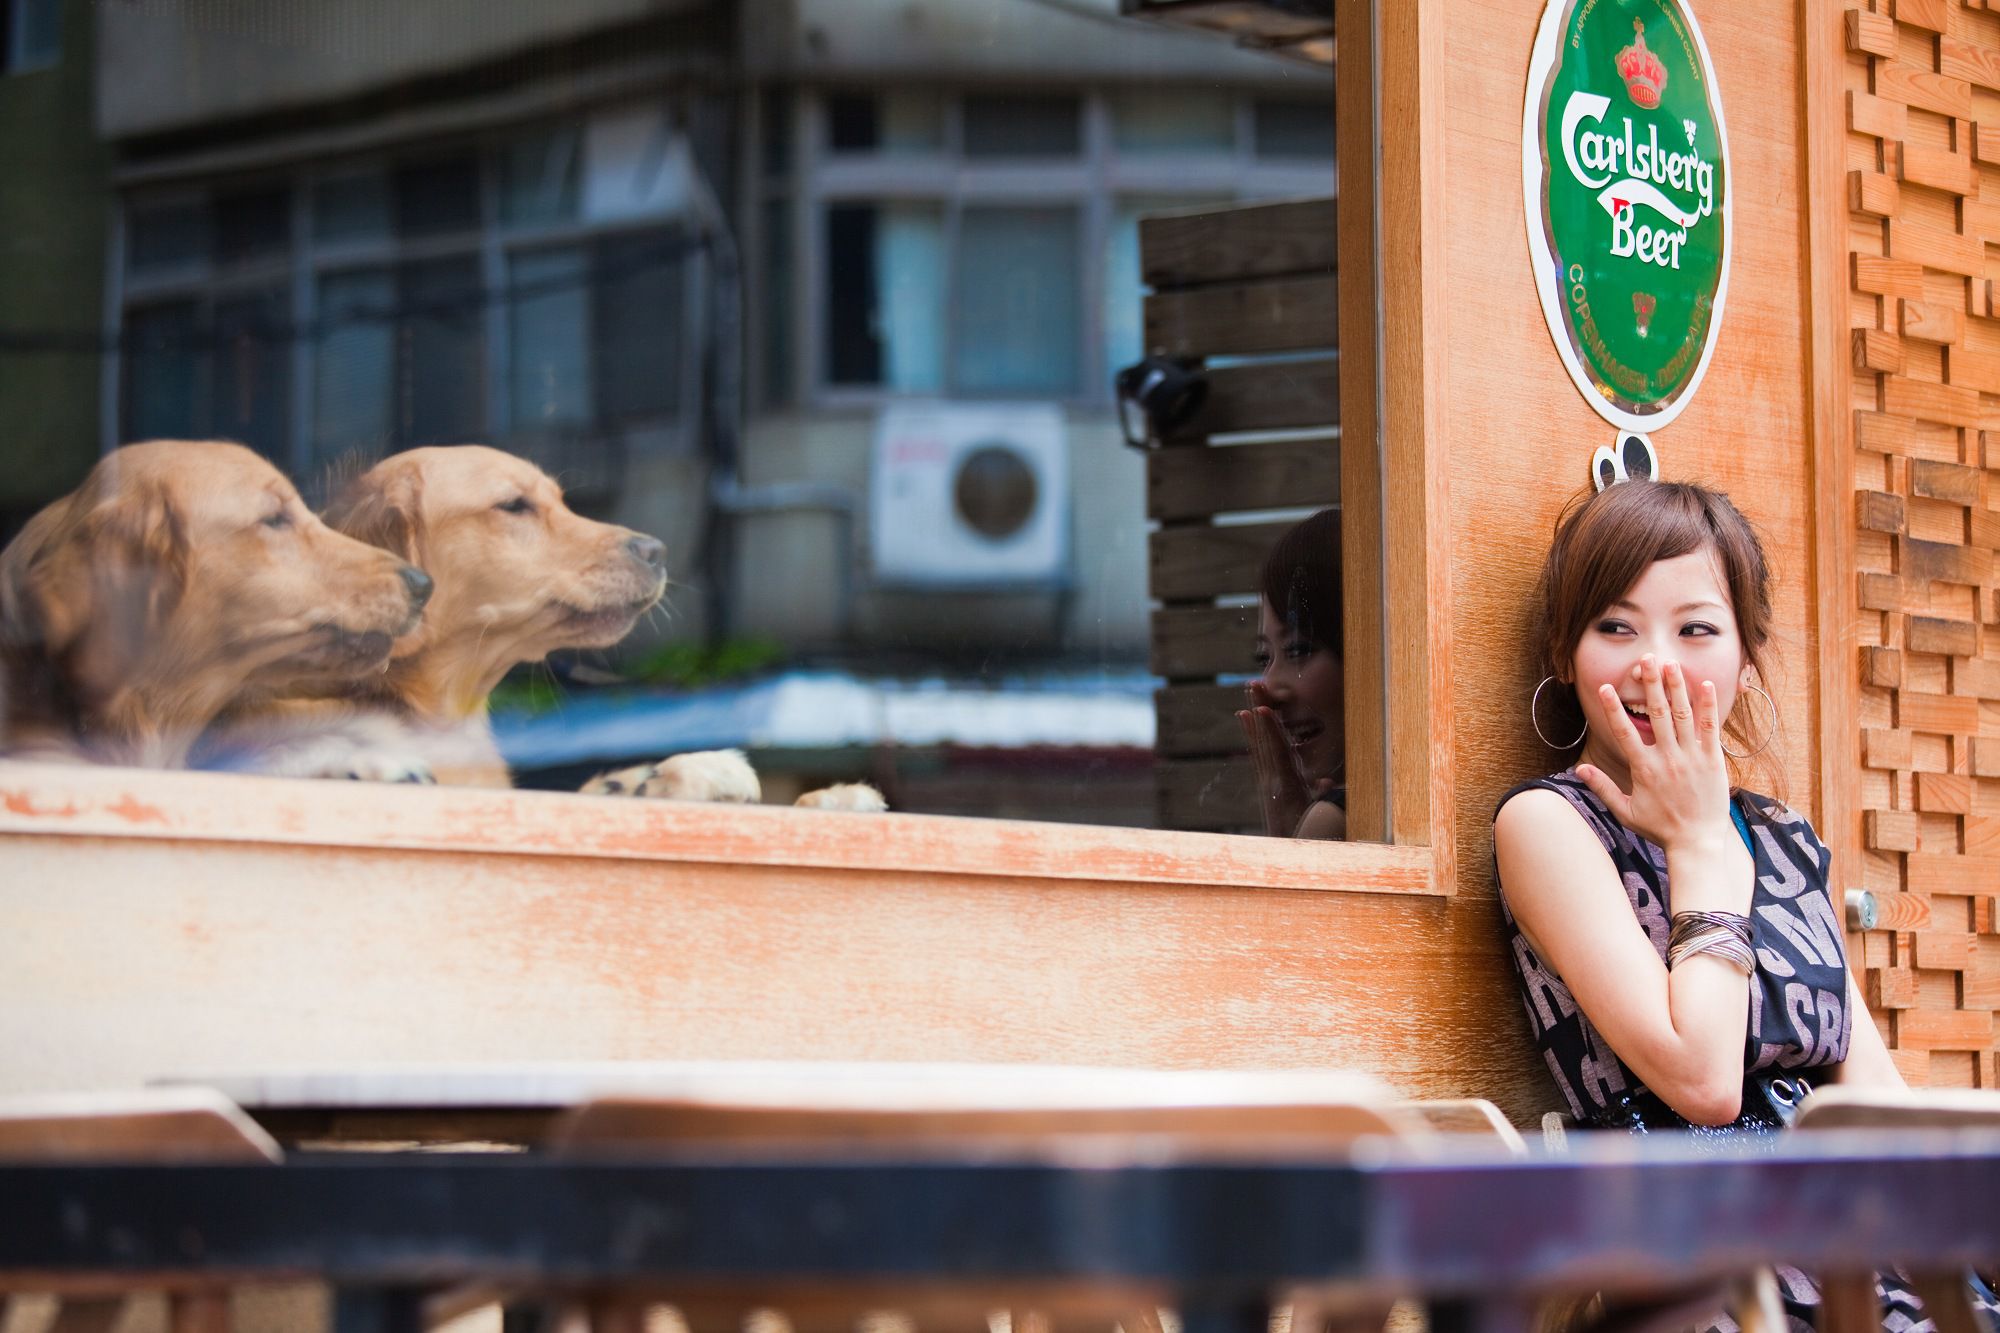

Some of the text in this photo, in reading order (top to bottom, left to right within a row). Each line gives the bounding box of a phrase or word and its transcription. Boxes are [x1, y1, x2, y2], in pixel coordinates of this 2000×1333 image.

[1577, 0, 1599, 32] APPOIN
[1683, 40, 1699, 80] COURT
[1561, 90, 1713, 217] Carlsberg
[1610, 203, 1687, 270] Beer
[1569, 263, 1648, 394] COPENHAGEN
